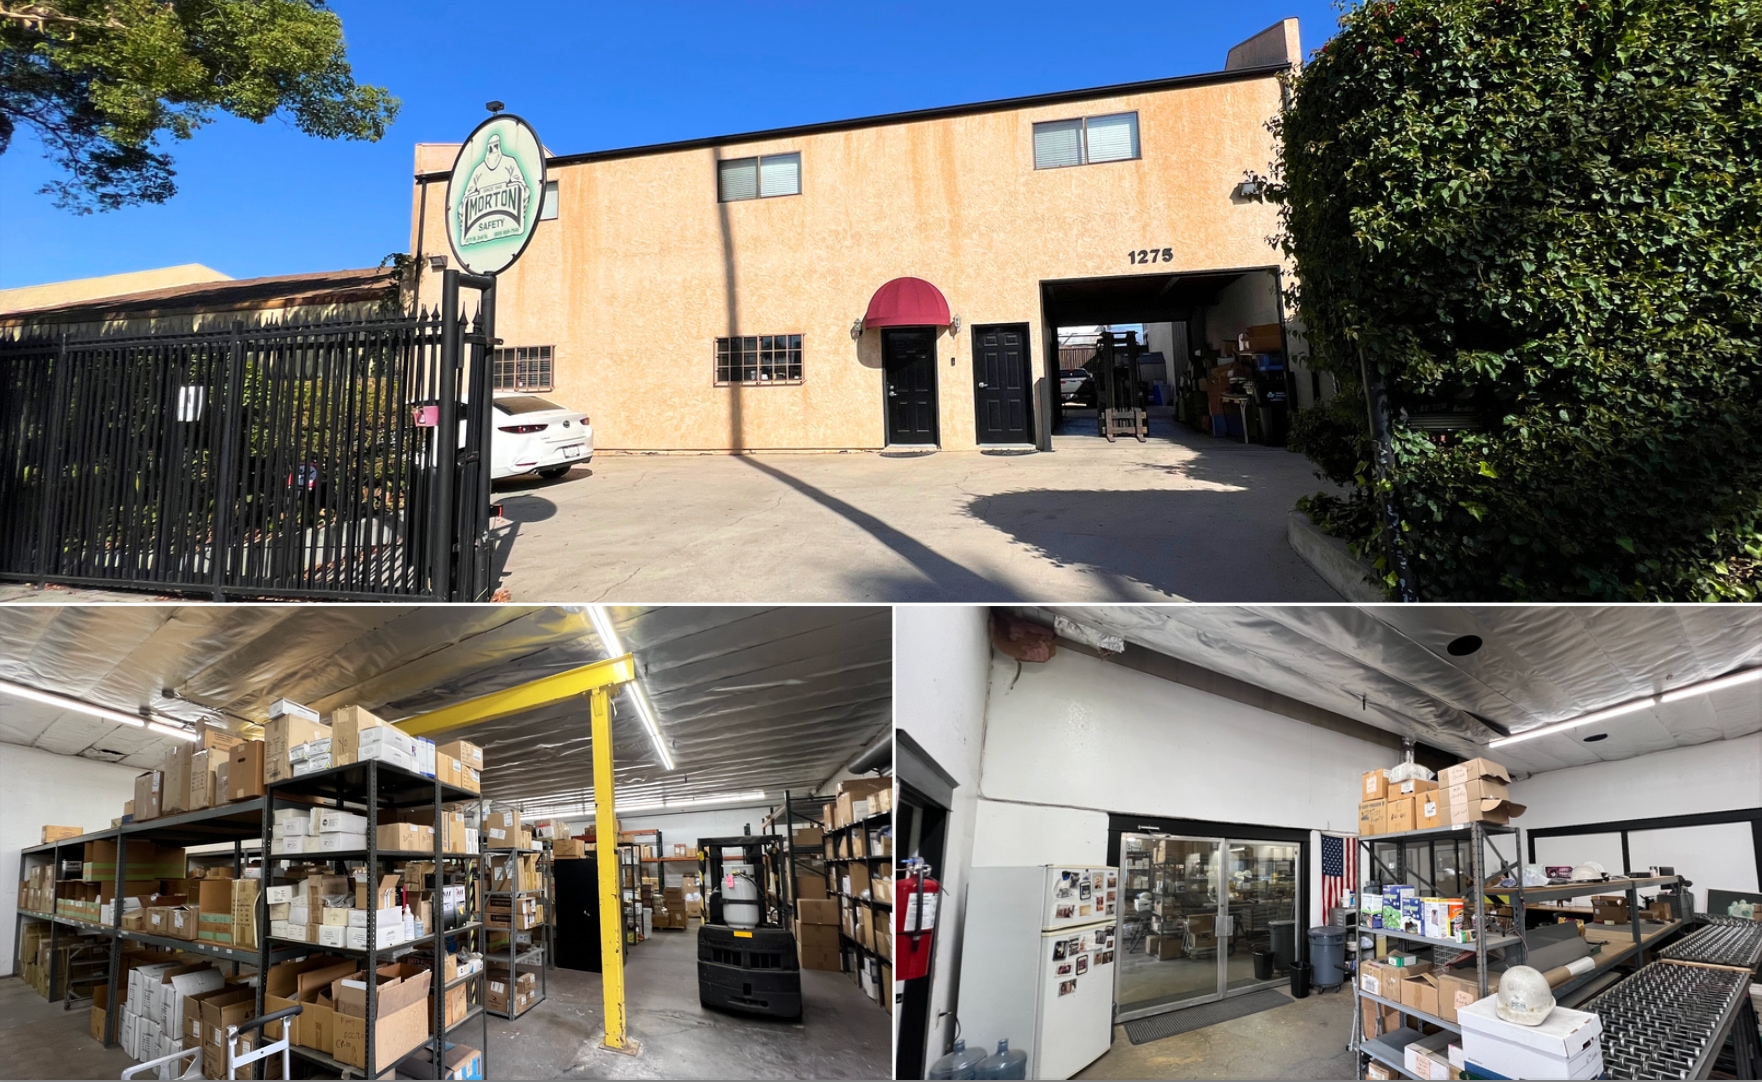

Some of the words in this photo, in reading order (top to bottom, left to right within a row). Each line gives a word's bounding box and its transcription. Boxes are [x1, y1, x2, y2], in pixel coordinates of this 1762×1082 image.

[469, 186, 516, 221] MORTON
[478, 218, 505, 231] SAFETY
[1128, 247, 1173, 265] 1275
